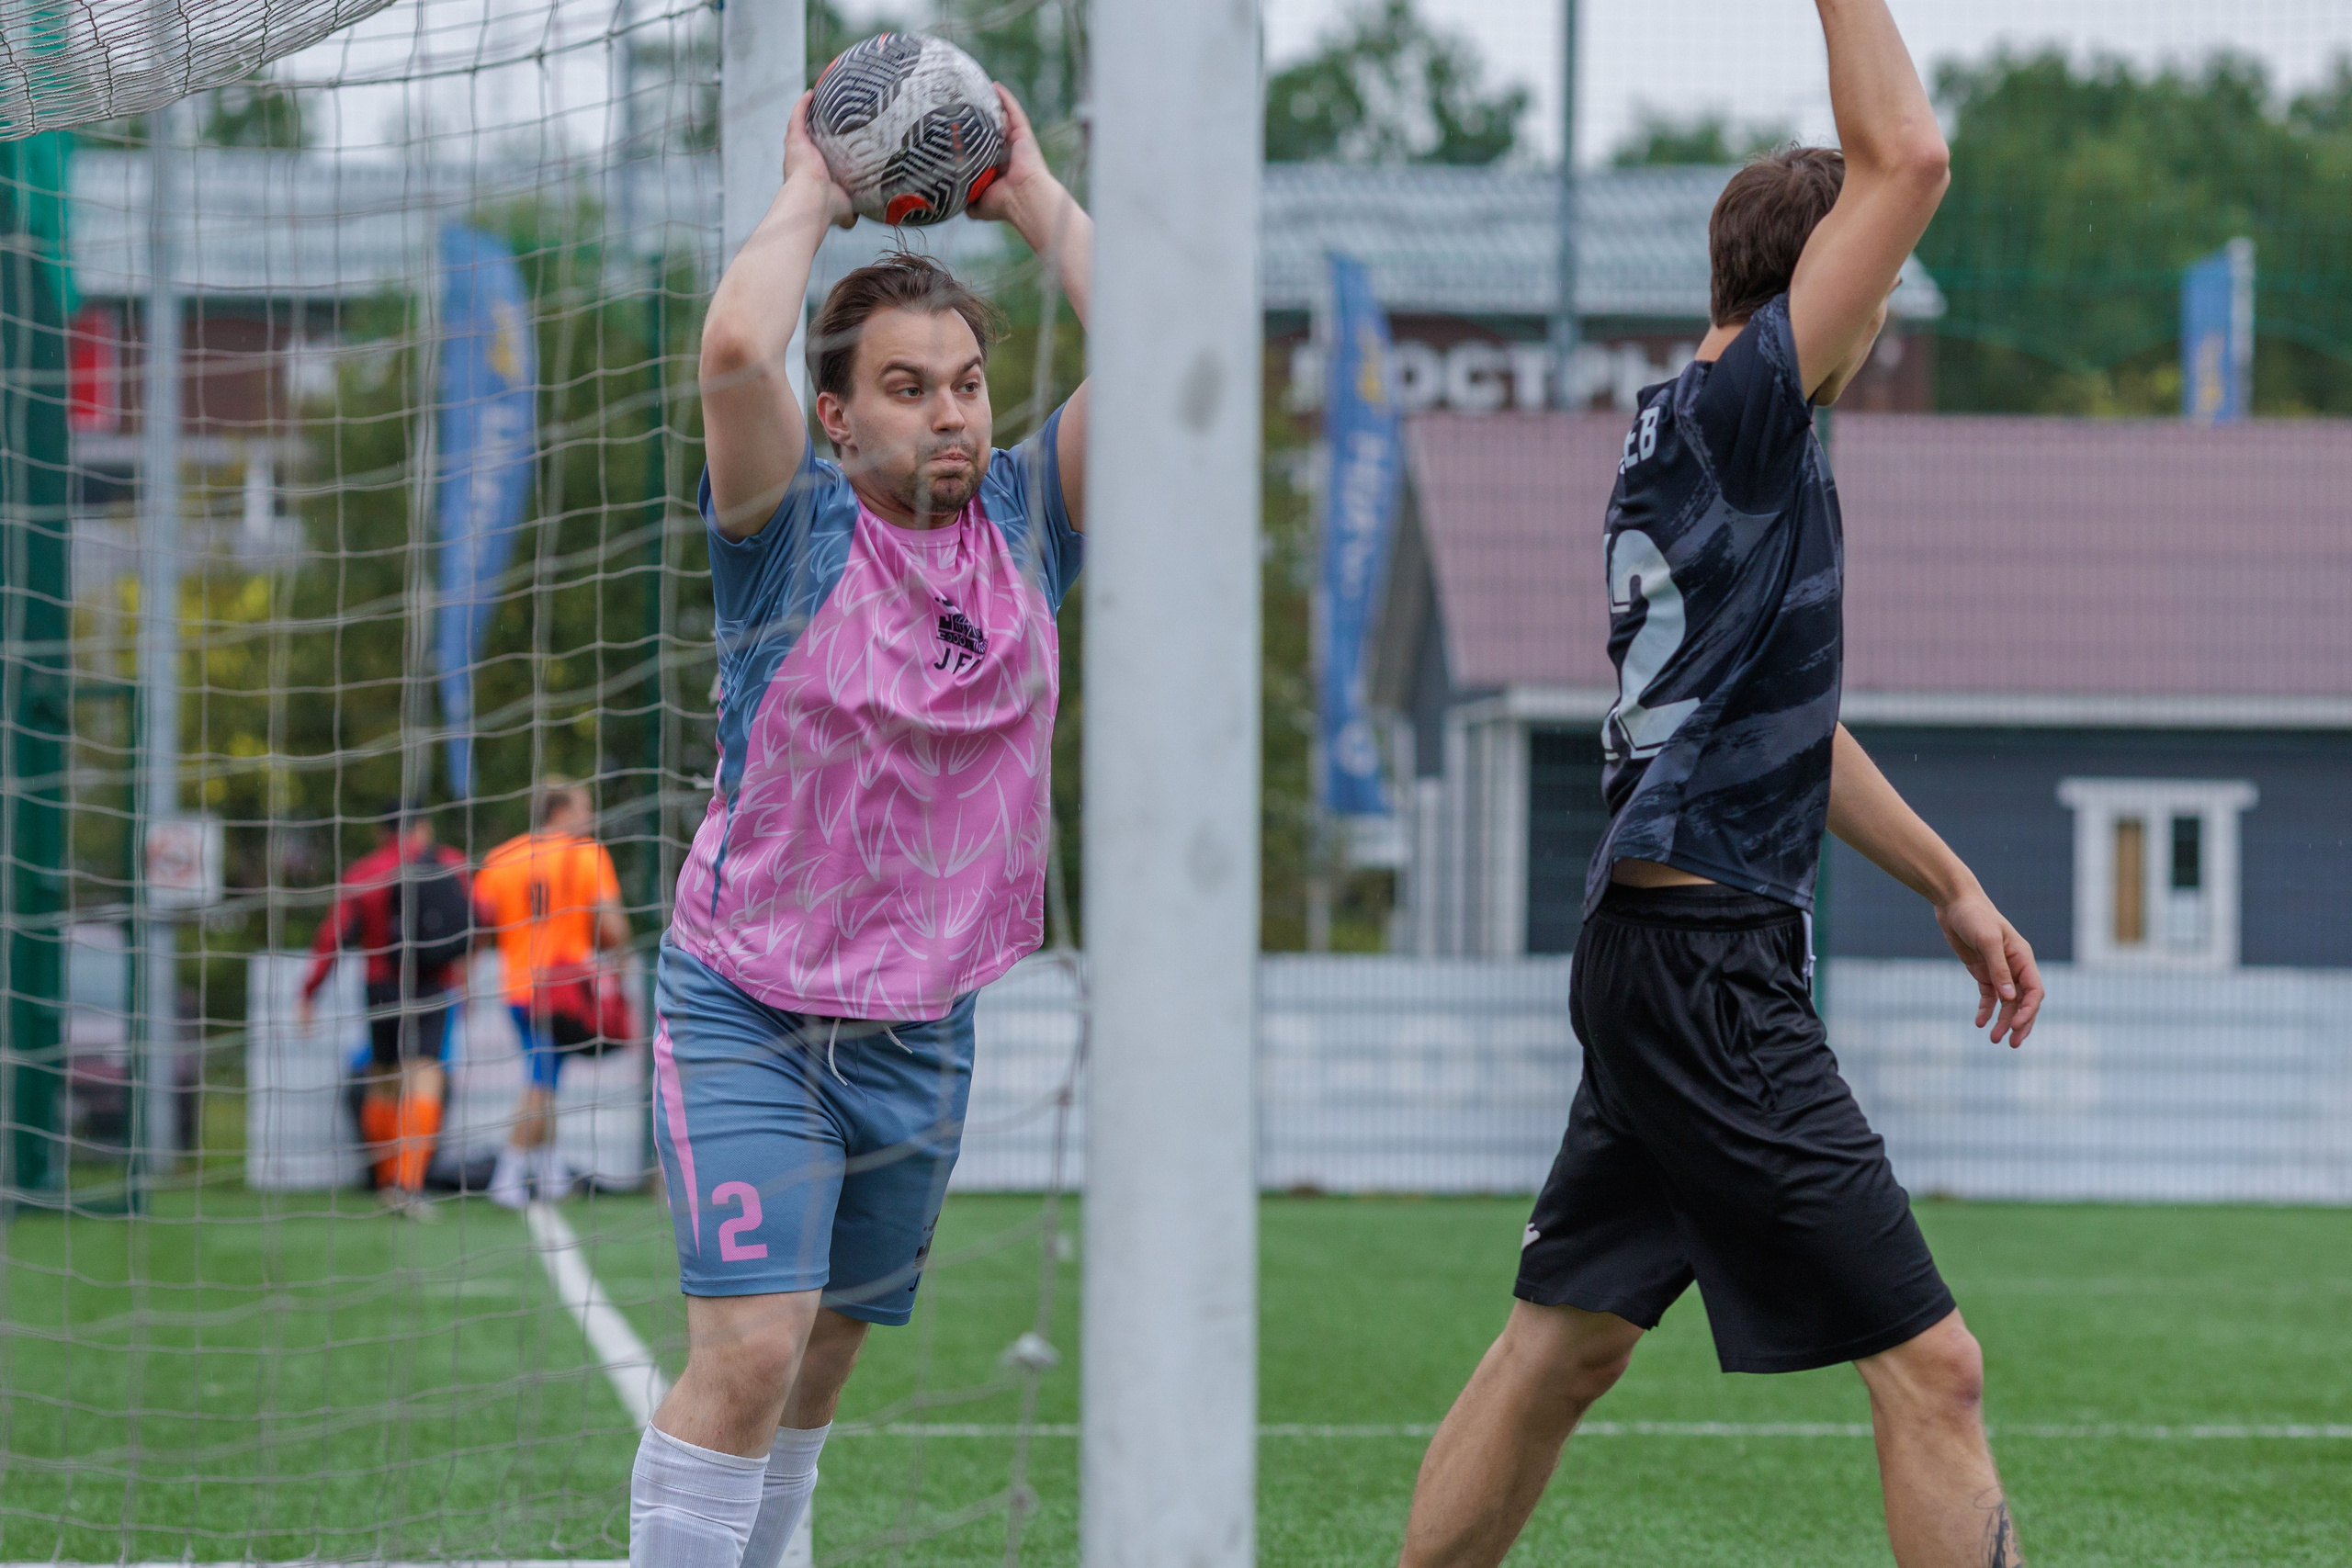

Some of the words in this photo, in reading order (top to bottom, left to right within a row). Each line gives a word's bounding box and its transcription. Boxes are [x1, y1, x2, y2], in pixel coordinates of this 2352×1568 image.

[1619, 406, 1660, 474] ЕВ
[933, 647, 981, 674] JF
[1601, 528, 1702, 761] 2
[711, 1180, 769, 1262] 2
